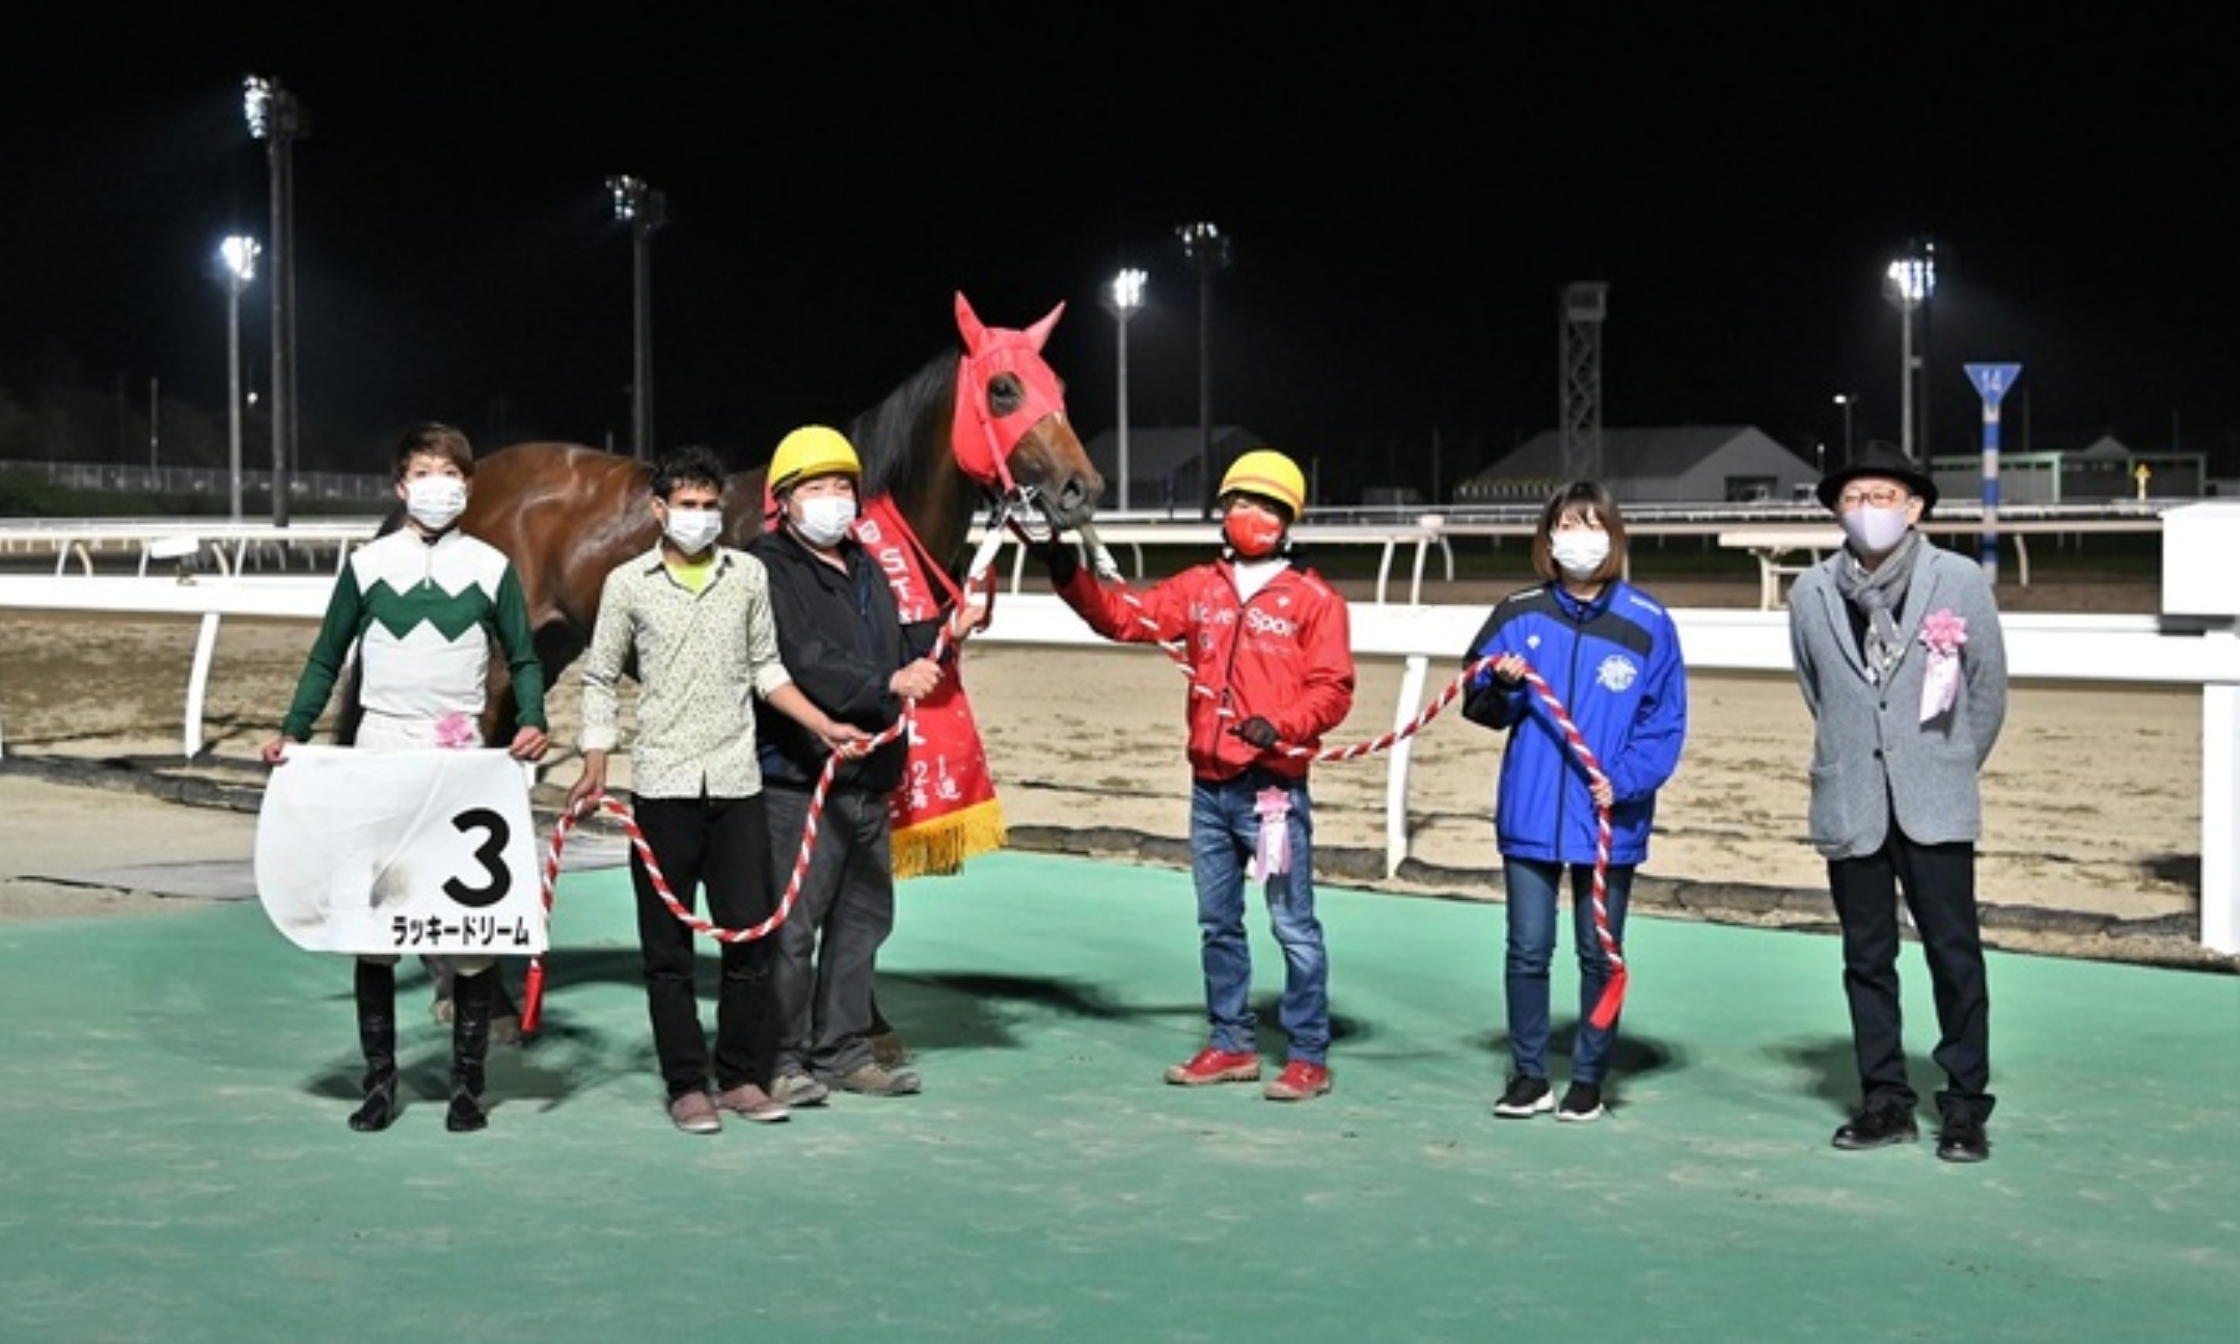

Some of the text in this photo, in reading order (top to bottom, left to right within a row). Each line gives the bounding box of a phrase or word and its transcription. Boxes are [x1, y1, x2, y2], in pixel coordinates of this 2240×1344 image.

[442, 808, 512, 908] 3
[392, 915, 530, 946] ラッキードリーム
